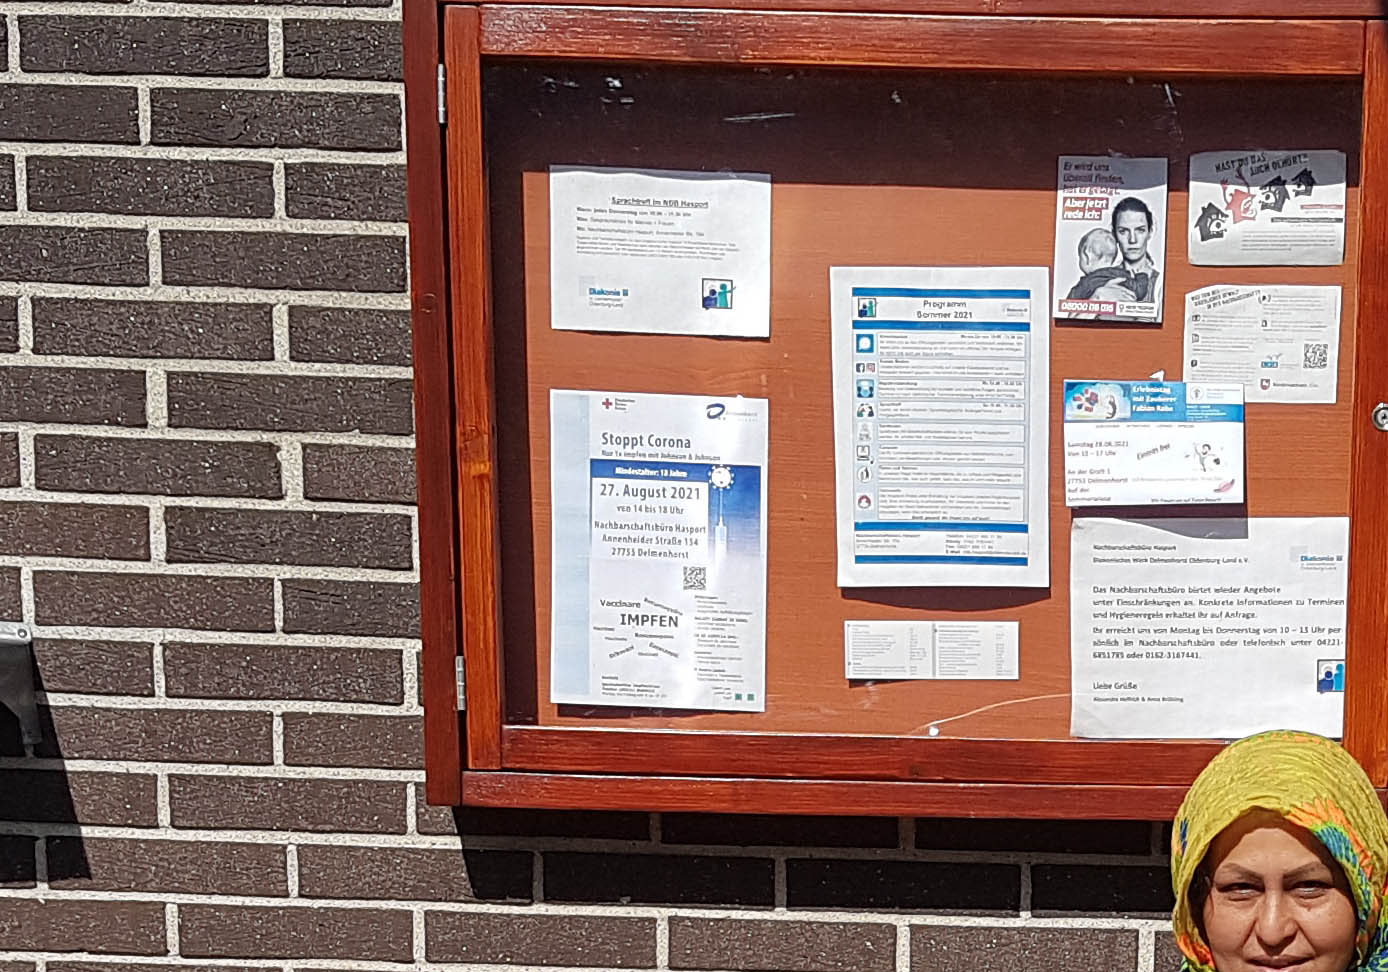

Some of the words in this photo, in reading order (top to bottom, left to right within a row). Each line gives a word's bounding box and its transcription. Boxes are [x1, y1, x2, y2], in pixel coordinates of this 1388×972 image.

[1064, 198, 1086, 208] Aber
[1086, 199, 1107, 210] jetzt
[1064, 209, 1084, 219] rede
[923, 300, 967, 309] Programm
[917, 311, 951, 319] Sommer
[953, 311, 973, 319] 2021
[602, 432, 644, 449] Stoppt
[648, 433, 691, 449] Corona
[600, 484, 619, 496] 27.
[623, 484, 667, 501] August
[671, 486, 700, 500] 2021
[634, 504, 643, 513] 14
[645, 505, 656, 514] bis
[659, 505, 668, 513] 18
[670, 505, 684, 515] Uhr
[594, 520, 673, 533] Nachbarschaftsbüro
[675, 524, 706, 536] Hasport
[602, 533, 653, 544] Annenheider
[655, 536, 682, 546] Straße
[638, 548, 689, 560] Delmenhorst
[1109, 586, 1186, 594] Nachbarschaftsbüro
[1243, 586, 1281, 595] Angebote
[1116, 598, 1181, 607] Einschränkungen
[1308, 598, 1345, 606] Terminen
[620, 613, 679, 628] IMPFEN
[1109, 611, 1163, 620] Hygieneregeln
[1210, 611, 1223, 619] auf
[1105, 626, 1135, 634] erreicht
[1169, 626, 1201, 636] Montag
[1202, 626, 1214, 634] bis
[1215, 626, 1261, 636] Donnerstag
[1280, 626, 1290, 634] 10
[1311, 626, 1325, 634] Uhr
[1138, 638, 1215, 646] Nachbarschaftsbüro
[1220, 638, 1238, 646] oder
[1243, 638, 1286, 646] telefonisch
[1127, 651, 1144, 659] oder
[1093, 681, 1112, 689] Liebe
[1114, 681, 1138, 689] Grüße
